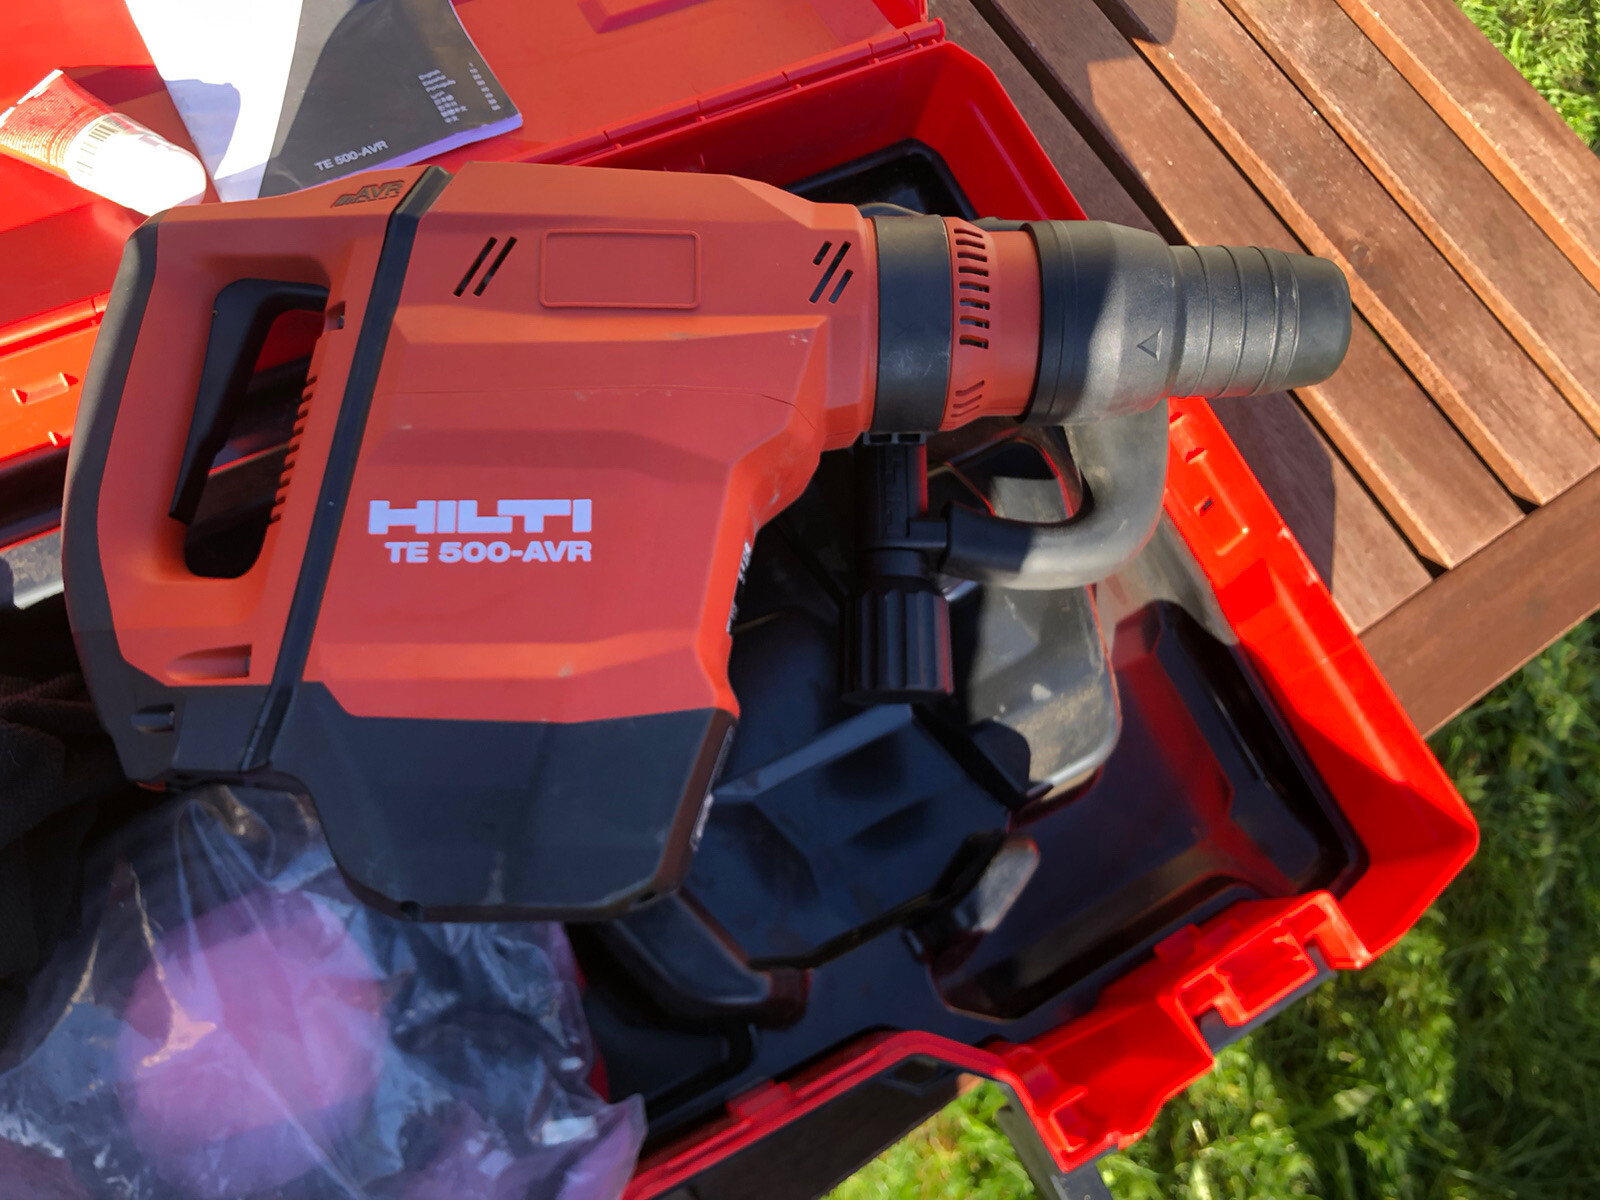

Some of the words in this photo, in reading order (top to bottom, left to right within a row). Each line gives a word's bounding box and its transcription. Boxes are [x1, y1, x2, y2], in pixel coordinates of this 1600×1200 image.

[314, 159, 334, 171] TE
[334, 140, 388, 165] 500-AVR
[368, 499, 592, 534] HILTI
[384, 541, 429, 563] TE
[438, 540, 592, 563] 500-AVR
